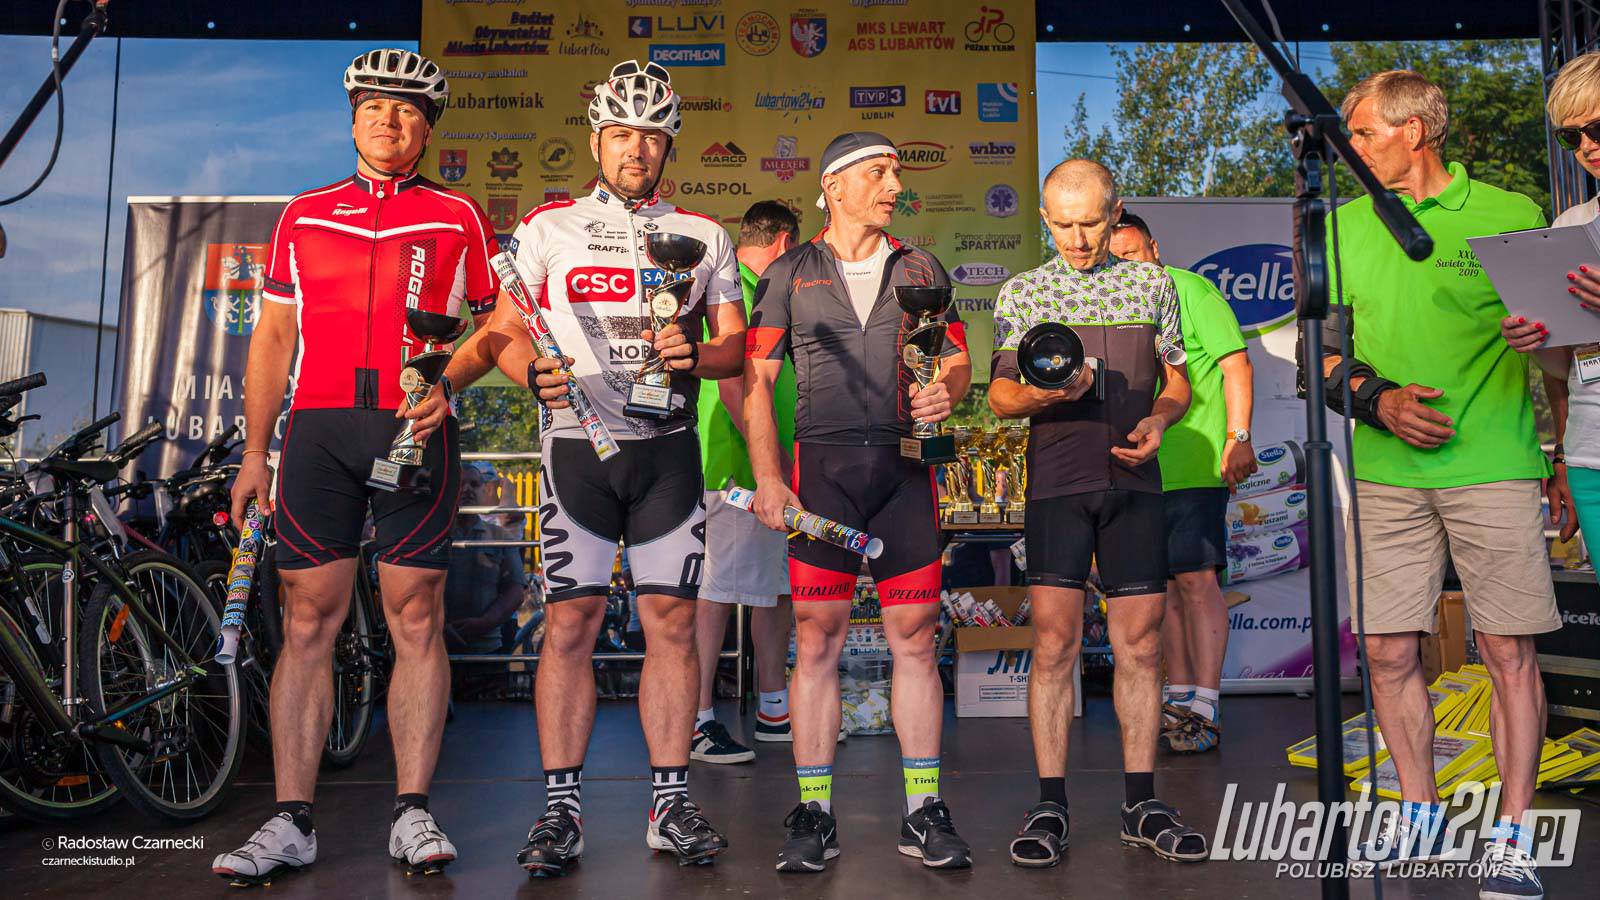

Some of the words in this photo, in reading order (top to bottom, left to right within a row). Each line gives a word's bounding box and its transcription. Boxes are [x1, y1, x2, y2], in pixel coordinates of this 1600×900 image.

[658, 15, 725, 31] LUVI
[857, 22, 885, 35] MKS
[890, 21, 945, 35] LEWART
[848, 38, 875, 51] AGS
[880, 34, 956, 50] LUBARTÓW
[653, 49, 720, 62] DECATHLON
[447, 92, 544, 109] Lubartowiak
[679, 98, 722, 112] owski
[861, 112, 895, 120] LUBLIN
[897, 150, 947, 162] MARIOL
[681, 182, 752, 195] GASPOL
[587, 244, 621, 254] CRAFT
[967, 267, 1005, 276] TECH
[1458, 268, 1479, 277] 2019
[570, 273, 629, 294] CSC
[1261, 449, 1284, 459] Stella
[1232, 520, 1243, 529] 60
